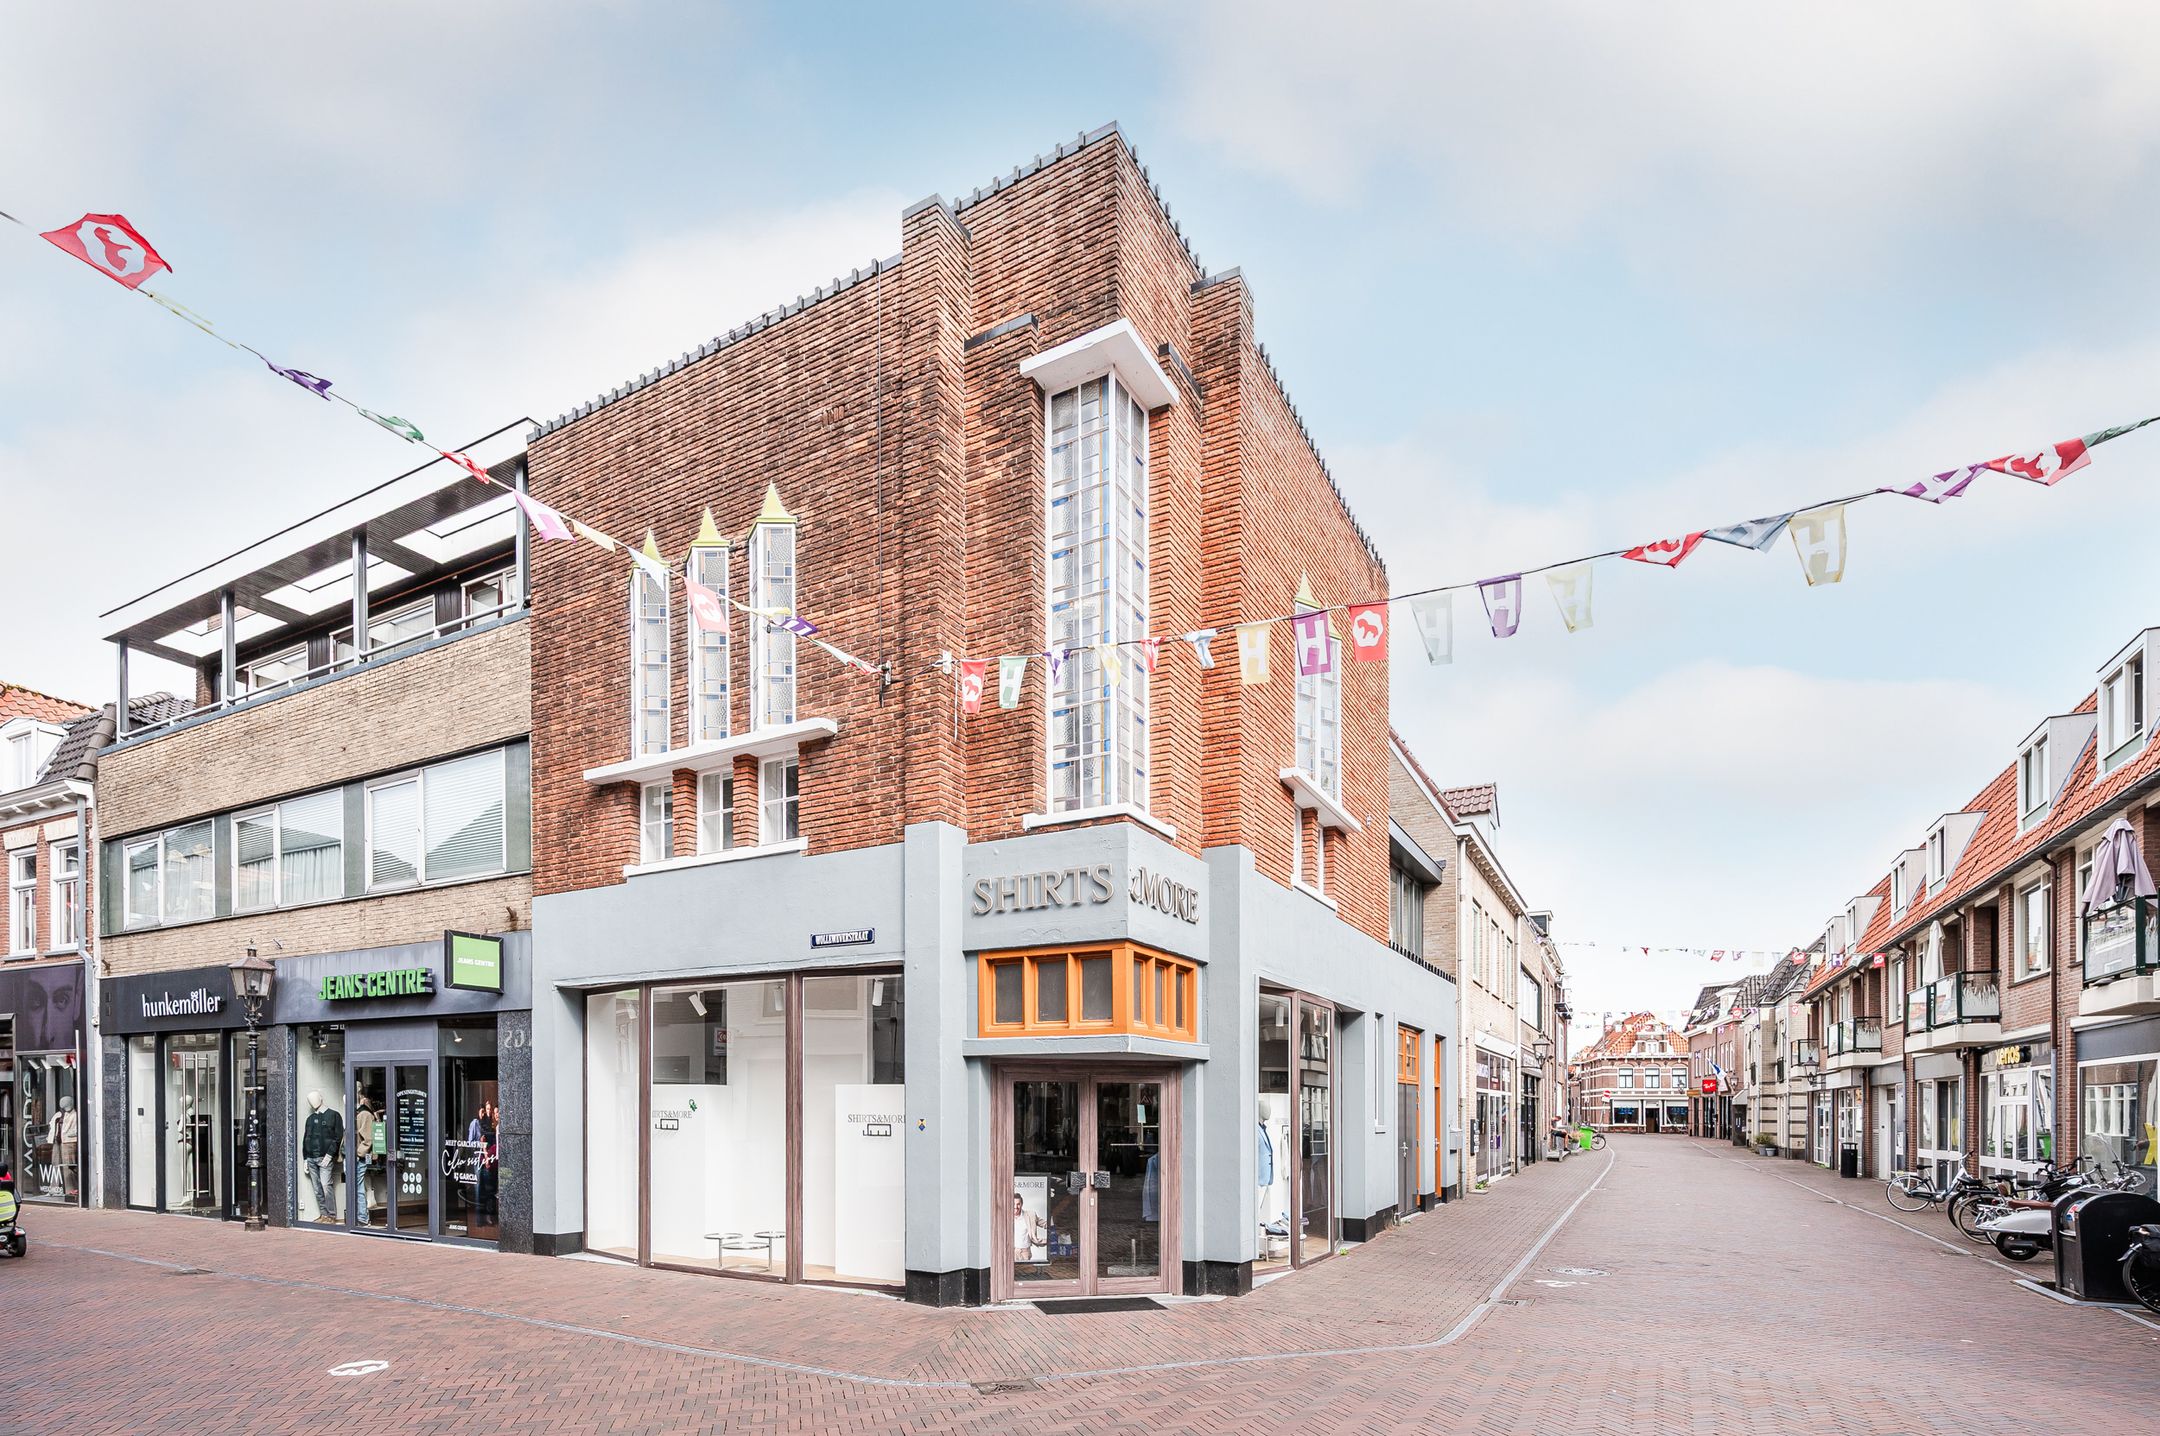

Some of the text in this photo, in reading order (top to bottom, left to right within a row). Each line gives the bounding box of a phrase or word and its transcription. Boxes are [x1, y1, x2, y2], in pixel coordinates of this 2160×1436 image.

[1240, 630, 1267, 676] H
[1296, 619, 1328, 668] H
[972, 863, 1116, 915] SHIRTS
[455, 957, 496, 967] JEANS CENTRE
[317, 967, 429, 1001] JEANS CENTRE
[141, 987, 221, 1018] hunkemöller
[39, 1163, 63, 1184] WM
